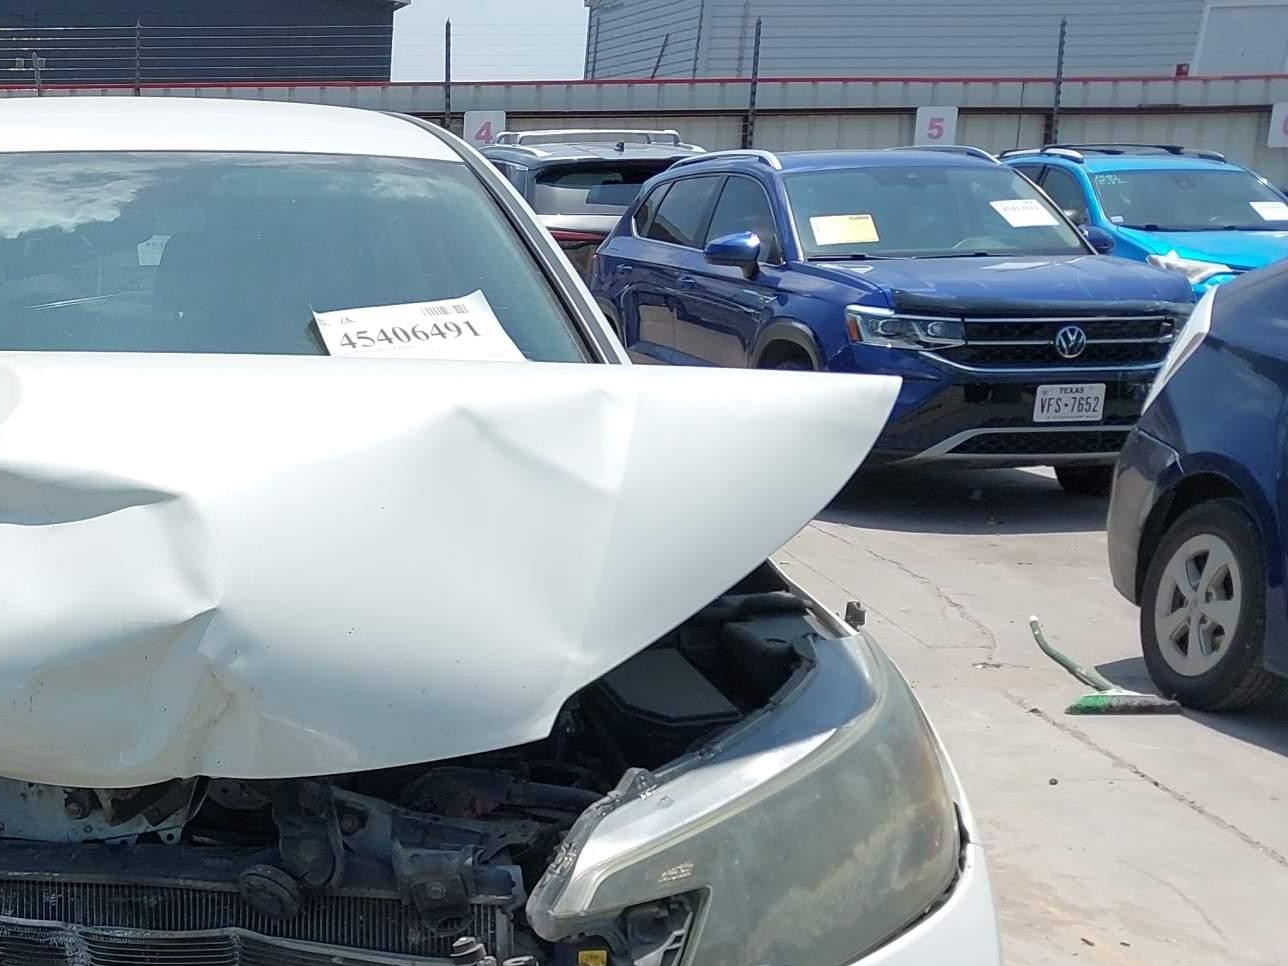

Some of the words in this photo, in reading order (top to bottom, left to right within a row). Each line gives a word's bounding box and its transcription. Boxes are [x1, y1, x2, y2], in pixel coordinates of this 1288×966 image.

[475, 121, 494, 144] 4
[928, 117, 944, 140] 5
[340, 320, 481, 350] 45406491
